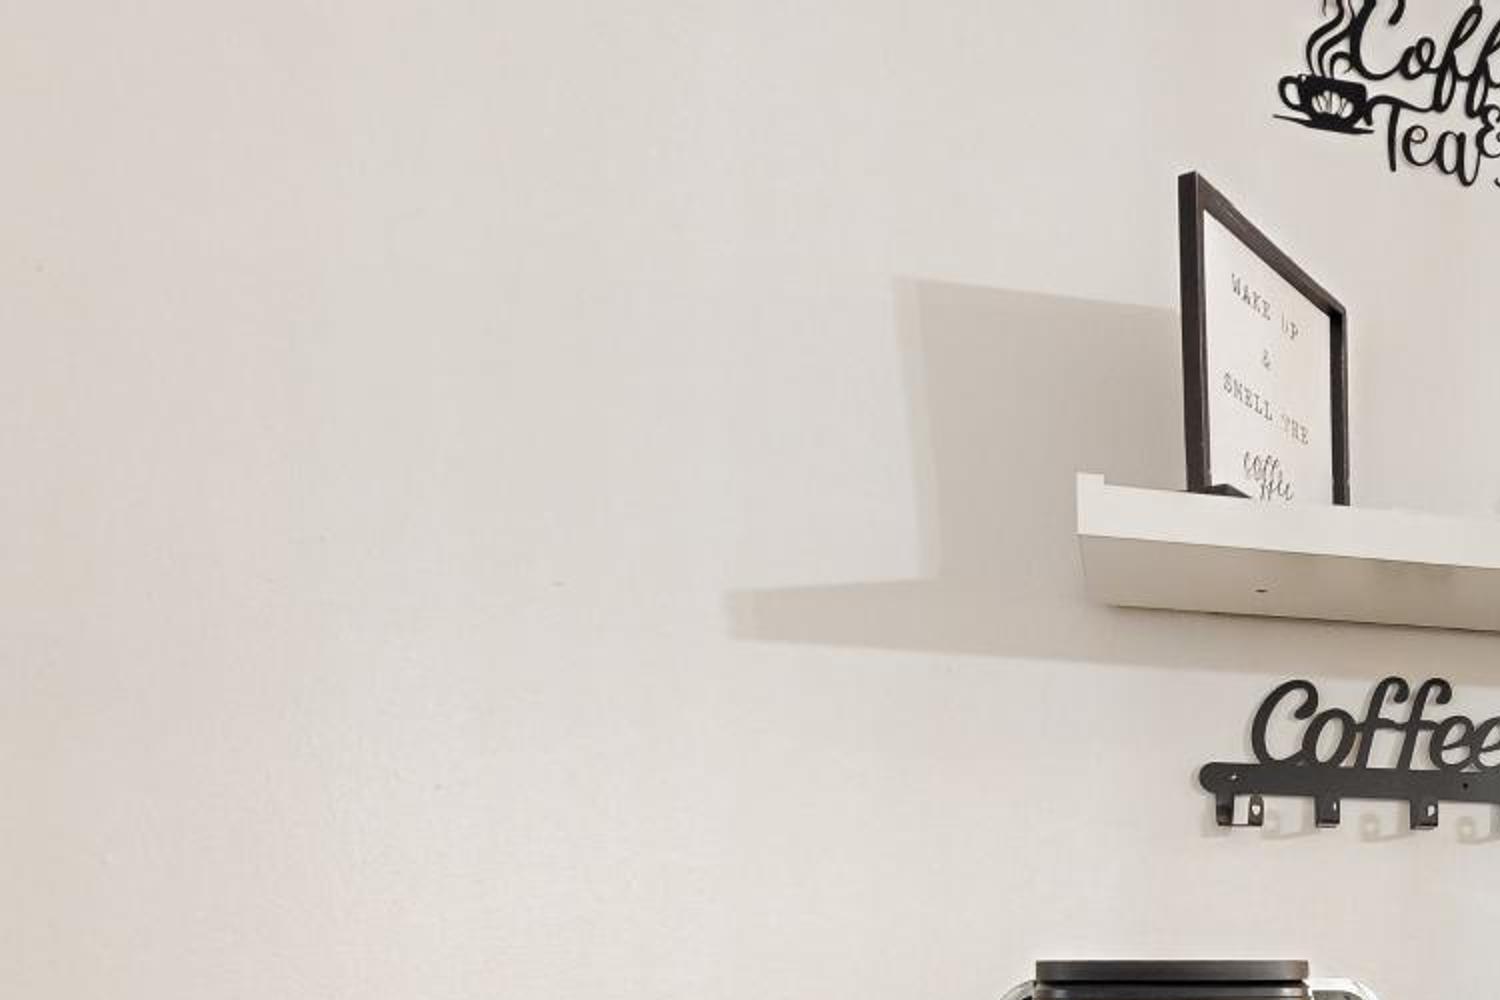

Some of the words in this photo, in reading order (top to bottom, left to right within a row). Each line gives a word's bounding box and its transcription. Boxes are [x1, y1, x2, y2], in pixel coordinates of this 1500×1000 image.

[1365, 95, 1482, 186] Tea
[1231, 273, 1271, 320] WAKE
[1281, 315, 1299, 340] UP
[1223, 372, 1273, 421] SMELL
[1281, 414, 1309, 445] THE
